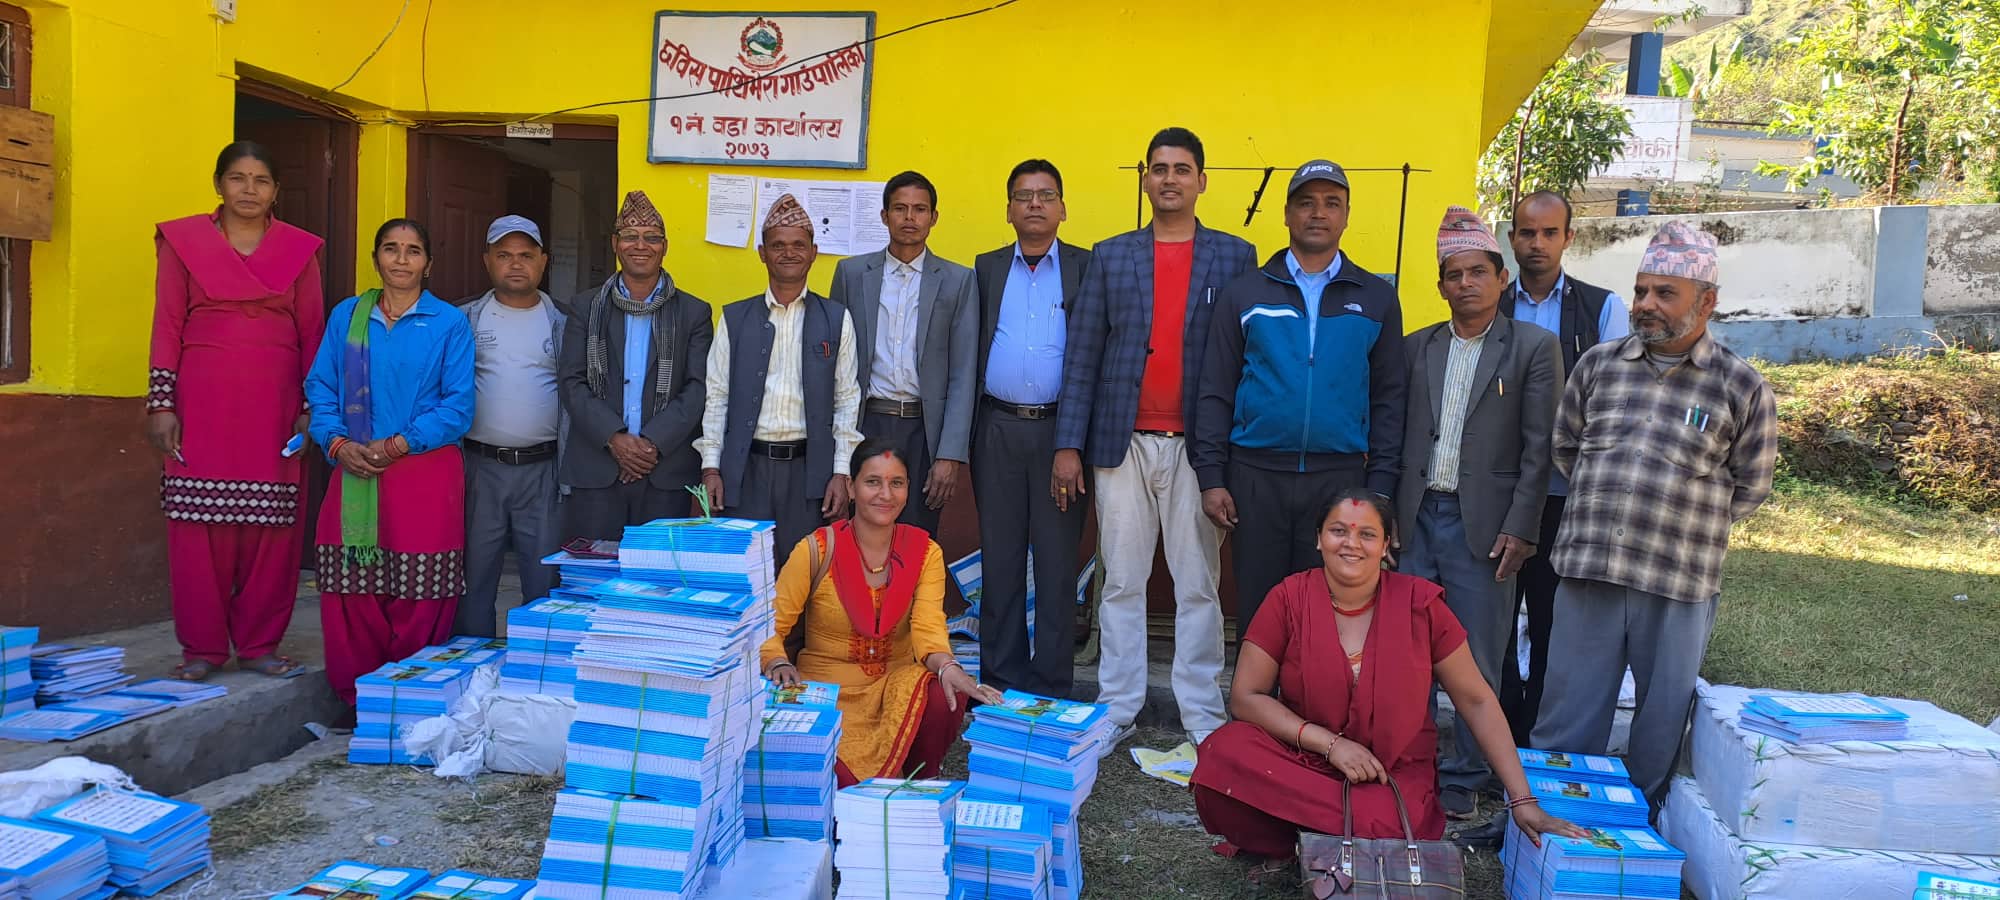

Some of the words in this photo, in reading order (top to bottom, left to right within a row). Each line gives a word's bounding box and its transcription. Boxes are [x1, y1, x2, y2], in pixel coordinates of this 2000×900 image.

[713, 116, 748, 138] वडा
[755, 112, 843, 141] कार्यालय
[726, 143, 769, 159] २०७३
